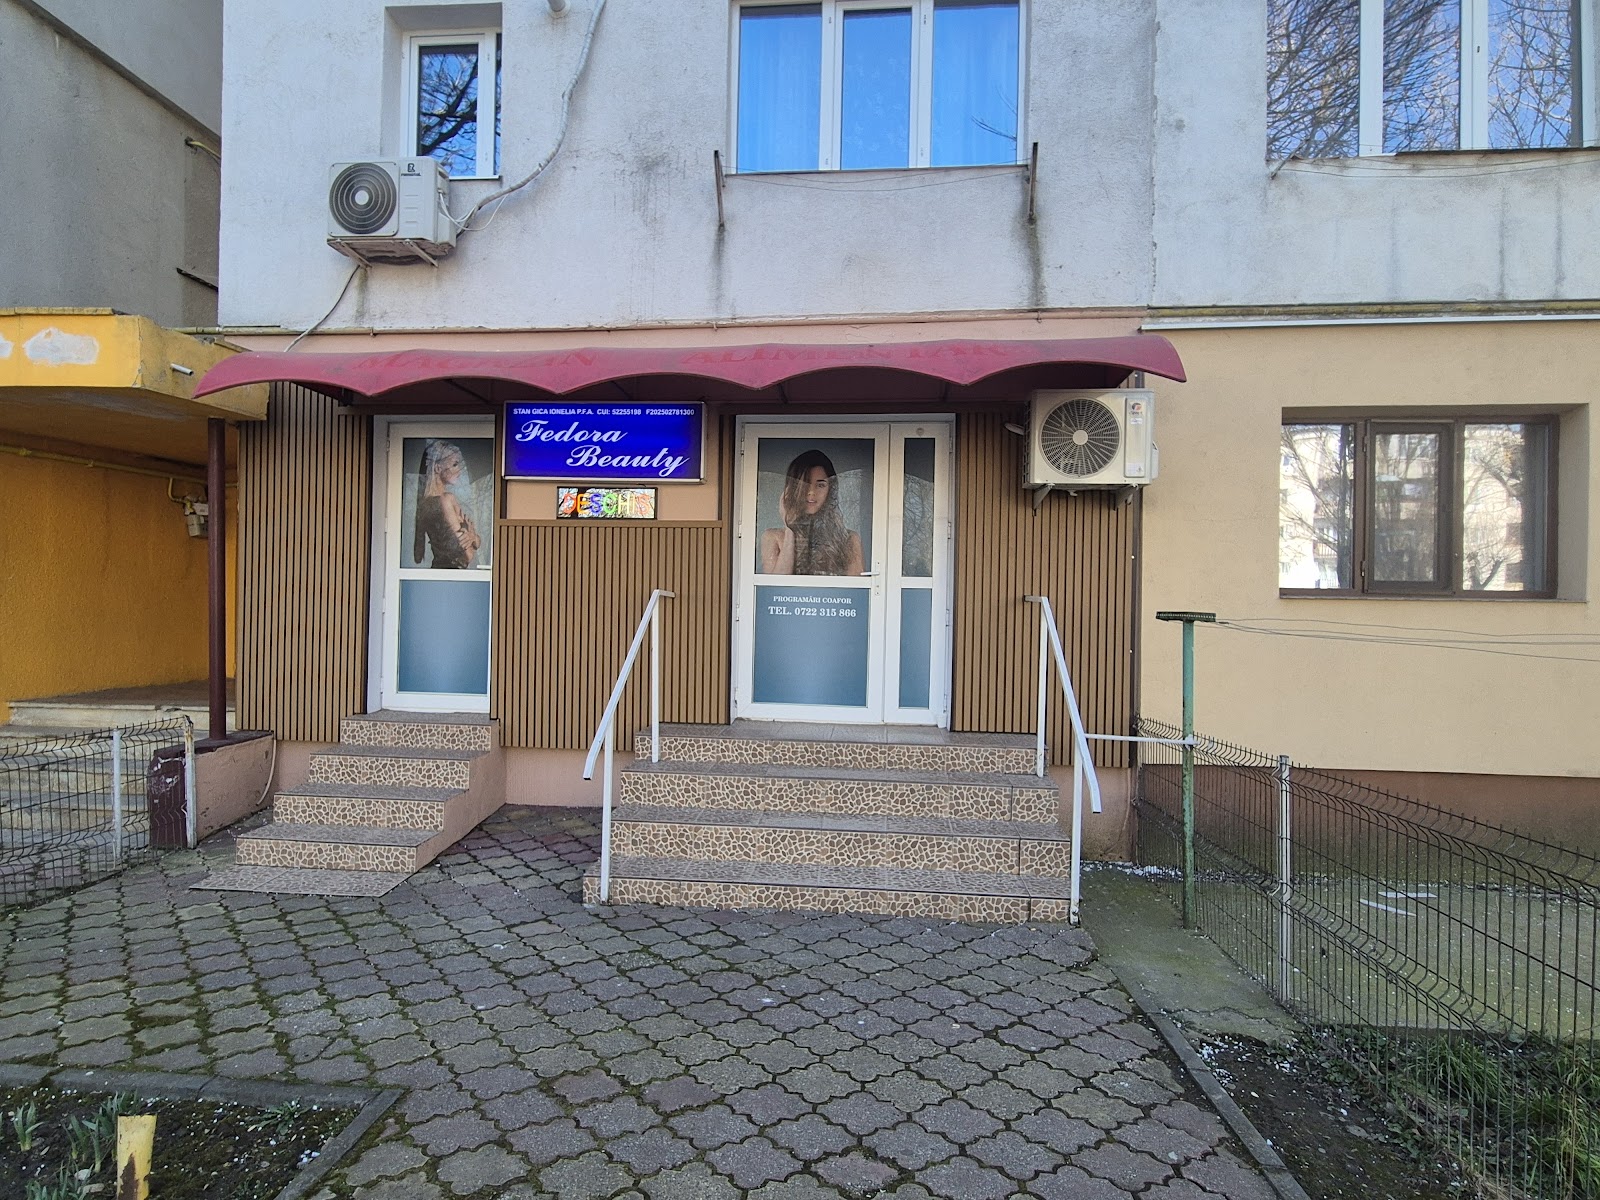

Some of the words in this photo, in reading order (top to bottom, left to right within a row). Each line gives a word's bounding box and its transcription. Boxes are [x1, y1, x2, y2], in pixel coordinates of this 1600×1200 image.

[612, 408, 642, 416] 52255198
[515, 420, 628, 442] Fedora
[566, 445, 689, 477] Beauty
[563, 493, 651, 515] DESCHIS
[773, 595, 821, 603] PROGRAMĂRI
[768, 606, 792, 615] TEL.
[794, 607, 817, 616] 0722
[819, 608, 837, 617] 315
[839, 609, 857, 617] 866
